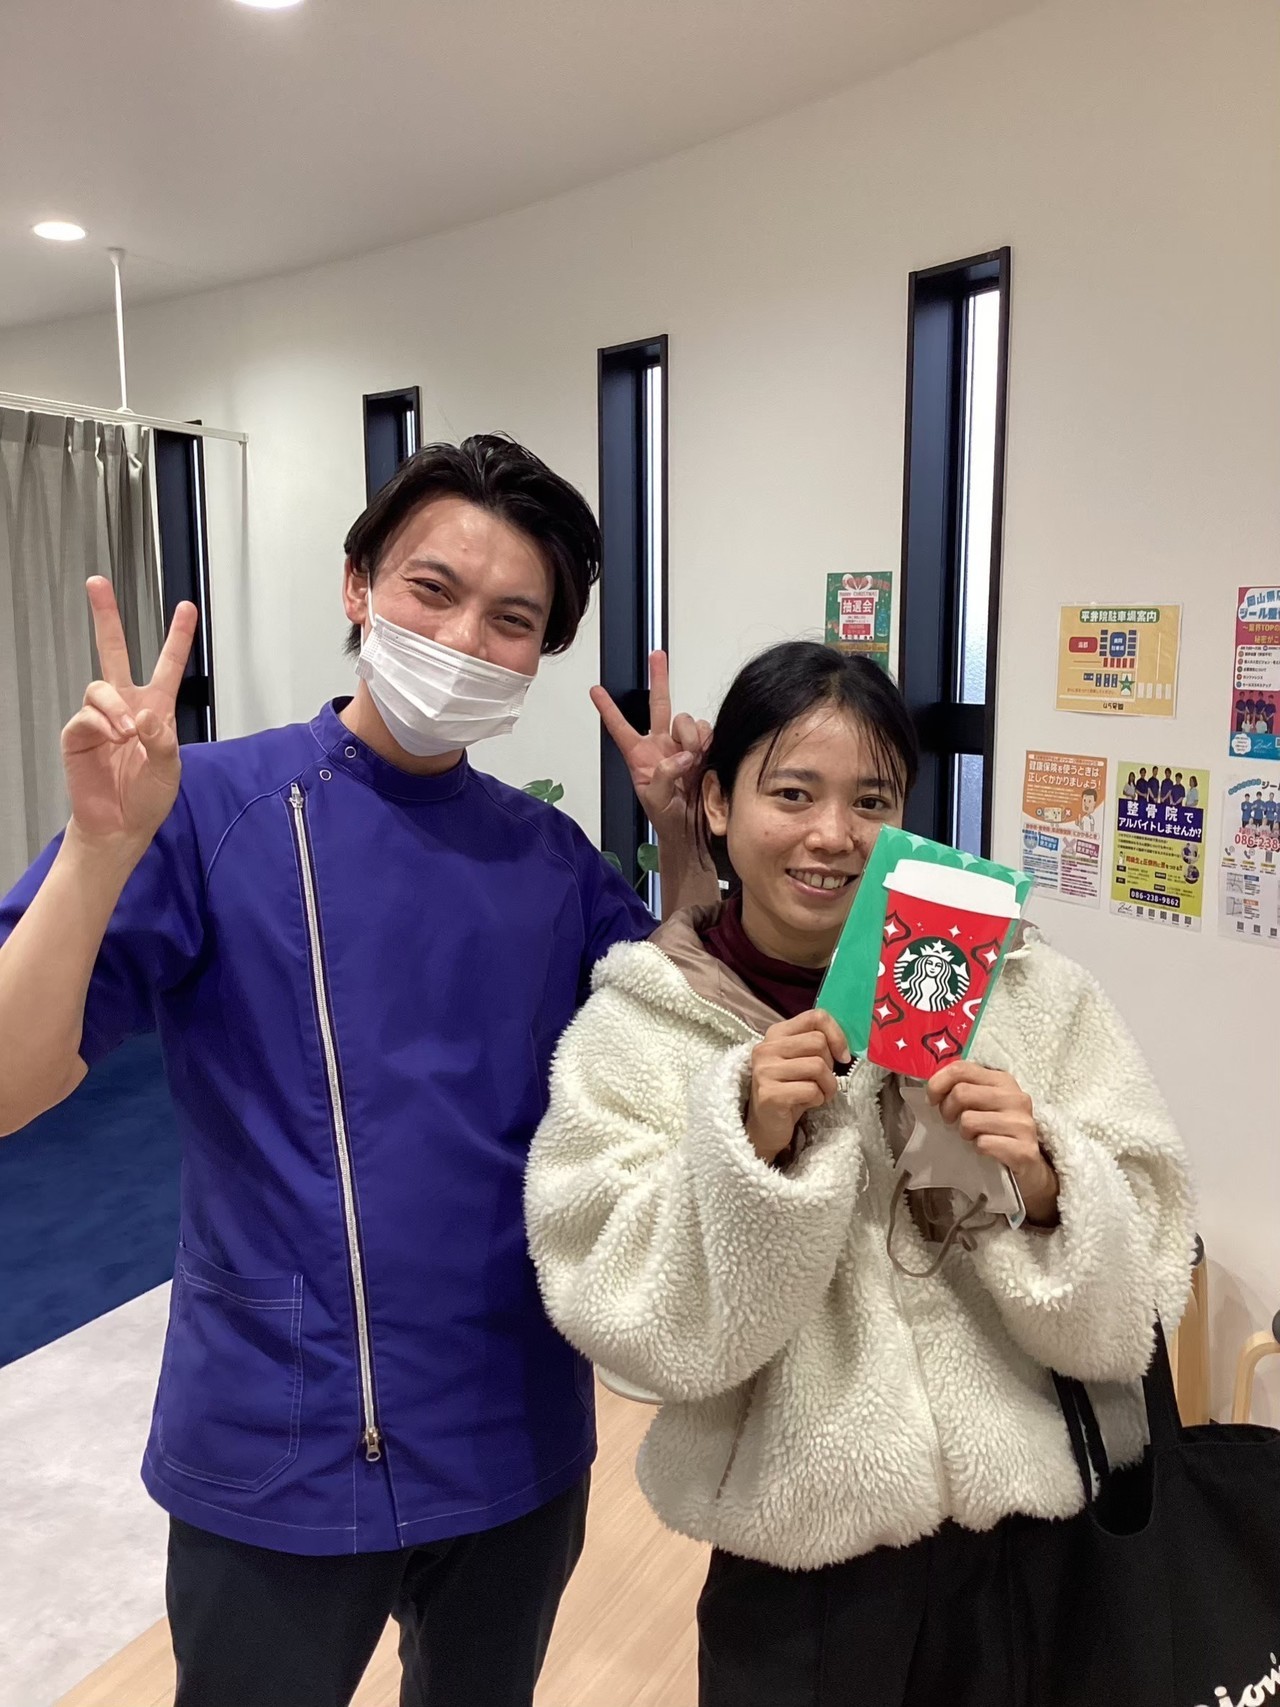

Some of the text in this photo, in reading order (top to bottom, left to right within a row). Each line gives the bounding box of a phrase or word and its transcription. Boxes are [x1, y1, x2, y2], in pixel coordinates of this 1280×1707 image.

[842, 599, 872, 613] 抽選会
[1029, 760, 1099, 777] 健康保険を使うときは
[1118, 817, 1202, 838] アルバイトしませんか?
[1130, 890, 1179, 907] 086-238-9862
